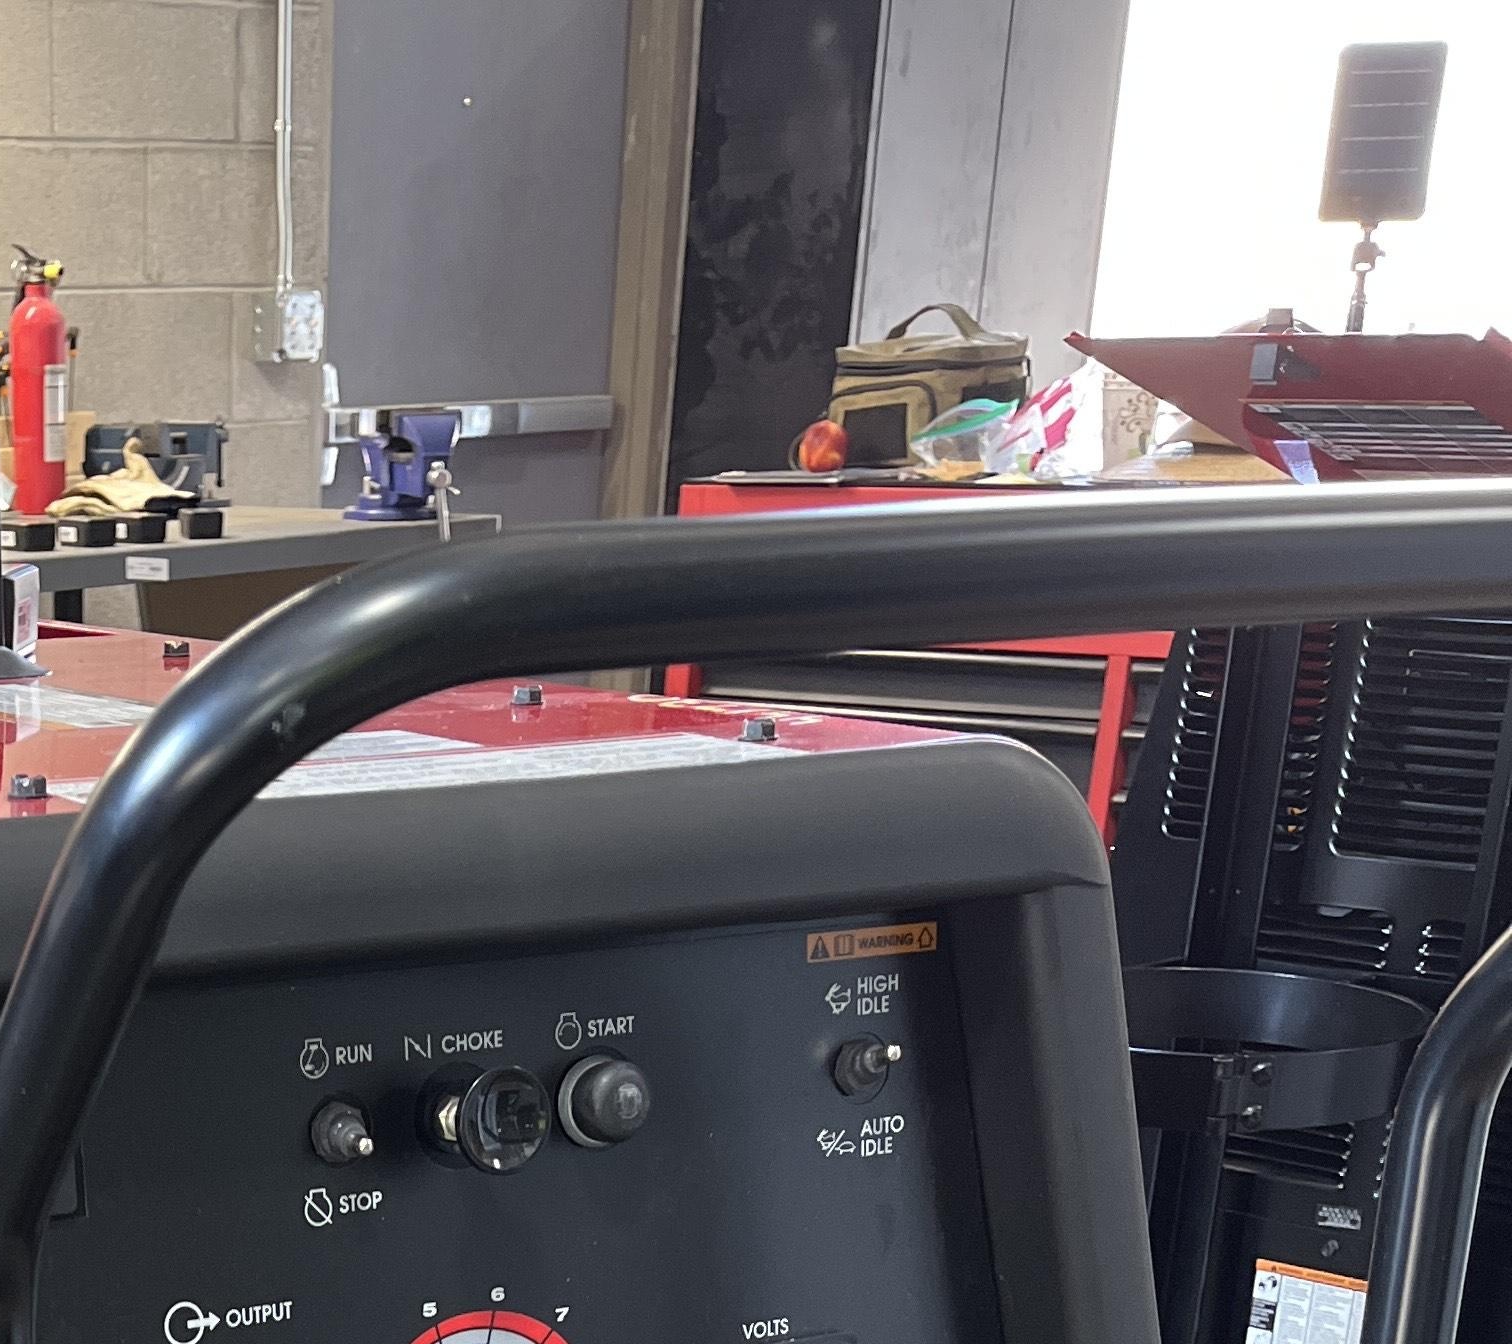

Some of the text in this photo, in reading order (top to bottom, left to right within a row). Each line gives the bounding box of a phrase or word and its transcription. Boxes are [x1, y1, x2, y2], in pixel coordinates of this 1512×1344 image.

[857, 932, 914, 949] WARNING
[857, 974, 900, 995] HIGH
[857, 995, 890, 1016] IDLE
[587, 1015, 635, 1038] START
[441, 1030, 504, 1054] CHOKE
[335, 1044, 373, 1065] RUN
[860, 1115, 905, 1137] AUTO
[861, 1136, 893, 1157] IDLE
[339, 1190, 383, 1214] STOP
[490, 1286, 506, 1302] 6
[225, 1301, 293, 1328] OUTPUT
[422, 1302, 438, 1317] 5
[554, 1307, 570, 1322] 7
[742, 1317, 790, 1340] VOLTS
